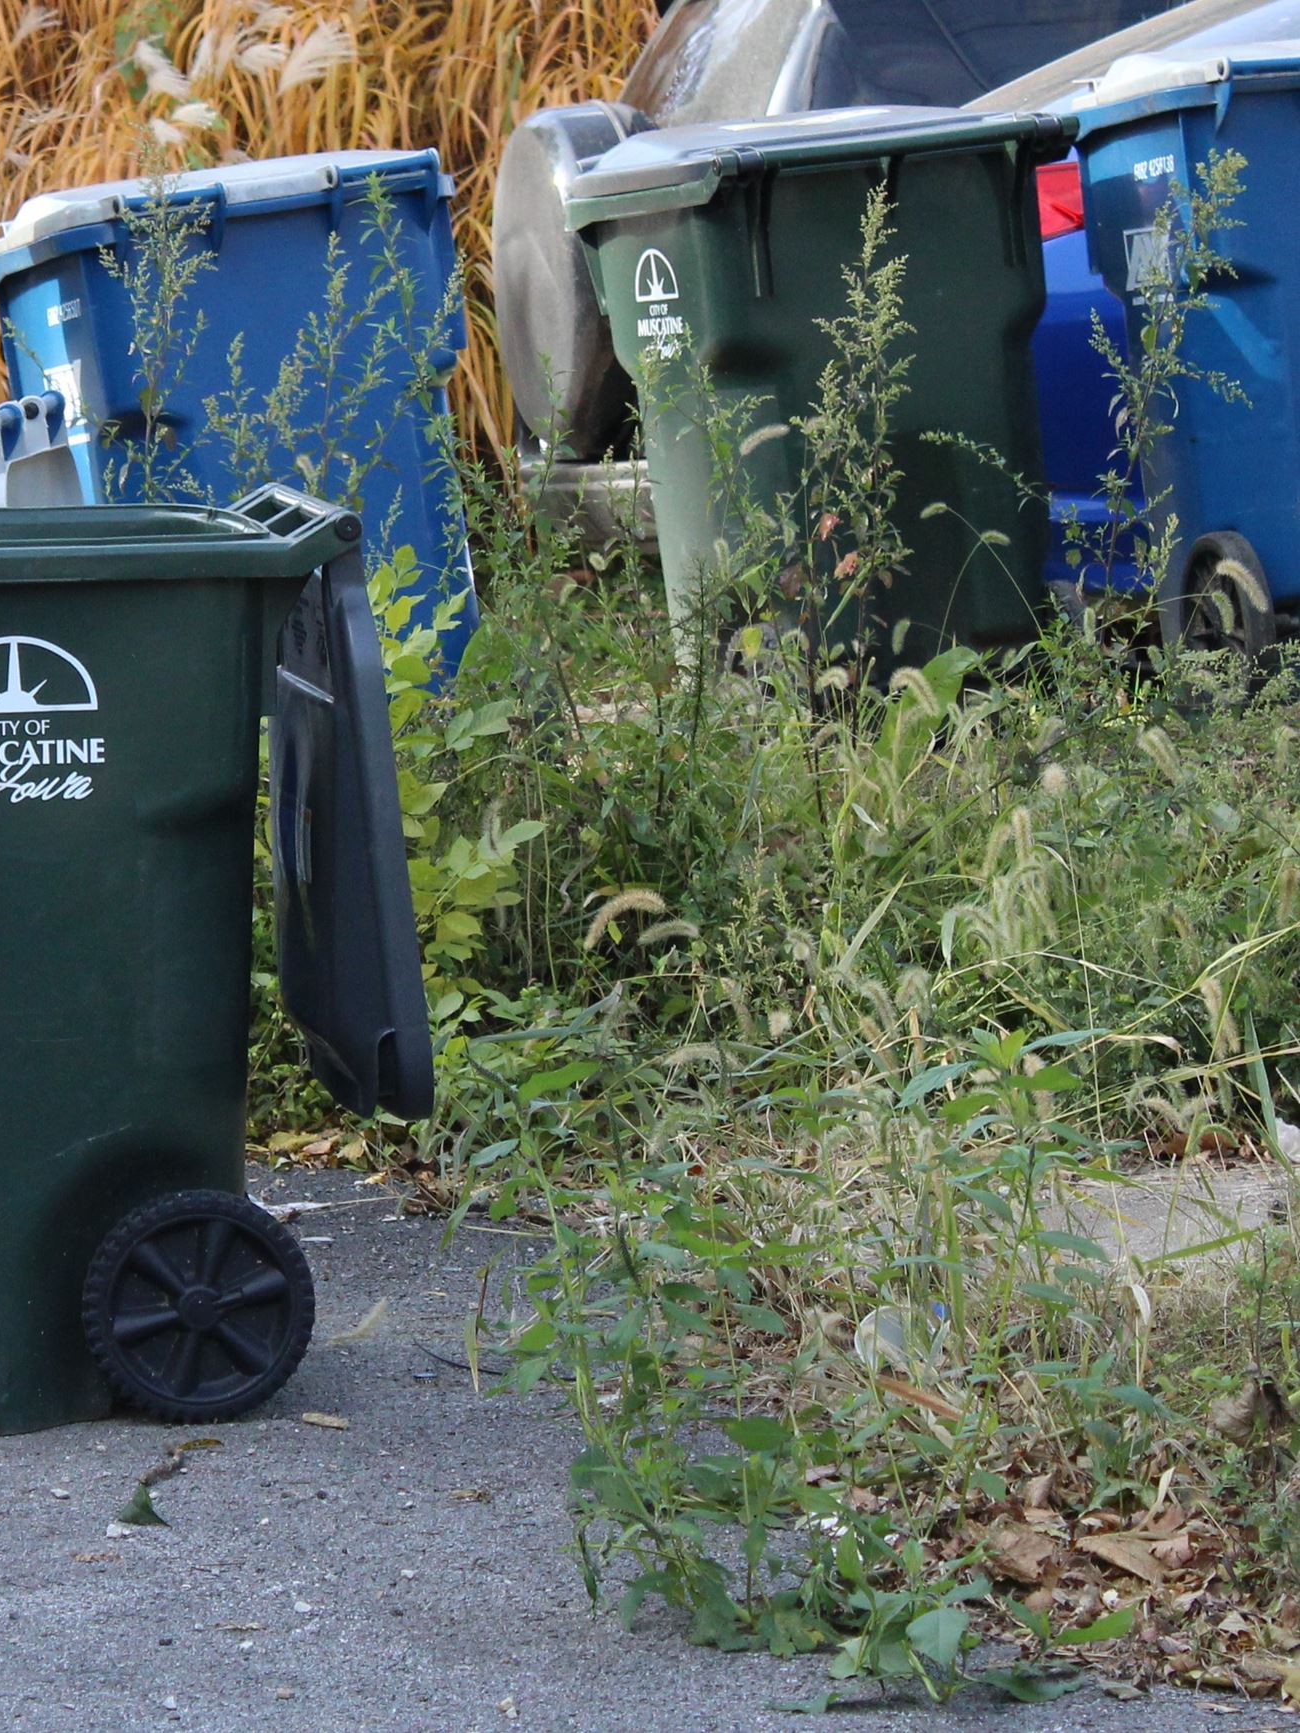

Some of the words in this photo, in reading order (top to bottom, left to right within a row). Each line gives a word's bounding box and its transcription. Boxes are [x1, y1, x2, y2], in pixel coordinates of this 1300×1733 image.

[649, 304, 660, 316] CITY
[660, 303, 668, 315] OF
[637, 316, 683, 337] MUSCATINE
[24, 719, 50, 736] OF
